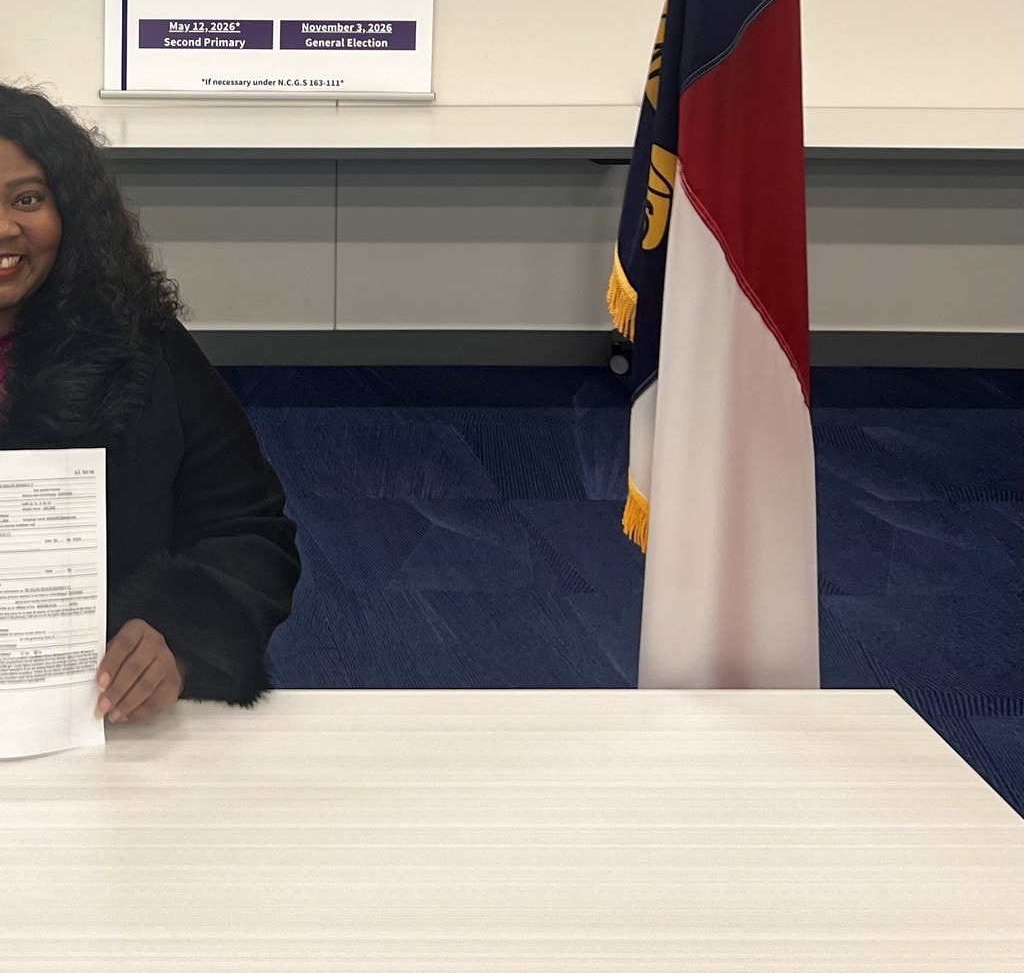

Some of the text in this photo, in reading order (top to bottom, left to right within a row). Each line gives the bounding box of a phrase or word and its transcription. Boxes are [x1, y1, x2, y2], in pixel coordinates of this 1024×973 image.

[169, 21, 191, 34] May
[192, 22, 209, 33] 12,
[301, 22, 393, 34] November 3, 2026
[163, 36, 246, 49] Second Primary
[305, 37, 388, 48] General Election
[212, 79, 252, 88] necessary
[252, 78, 277, 86] under
[277, 79, 308, 87] N.C.G.S
